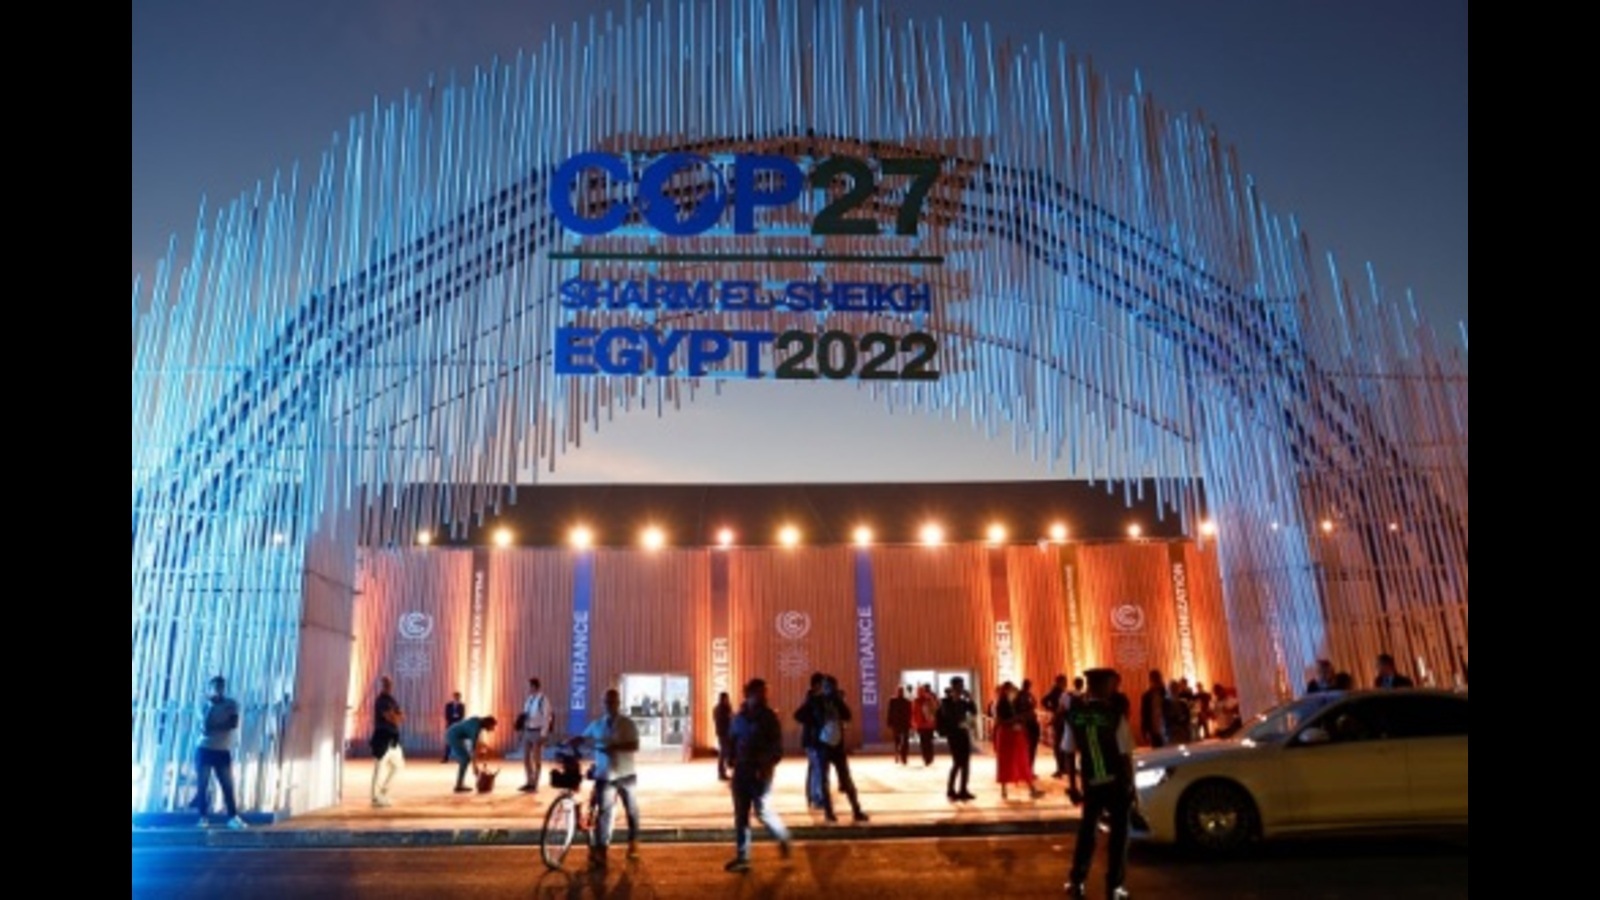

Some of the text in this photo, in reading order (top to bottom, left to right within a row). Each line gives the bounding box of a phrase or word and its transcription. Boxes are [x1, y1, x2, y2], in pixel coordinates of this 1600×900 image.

[549, 151, 940, 236] COP27
[559, 279, 932, 313] SHARM EL-SHEIKH
[571, 610, 588, 710] ENTRANCE
[858, 605, 877, 705] ENTRANCE
